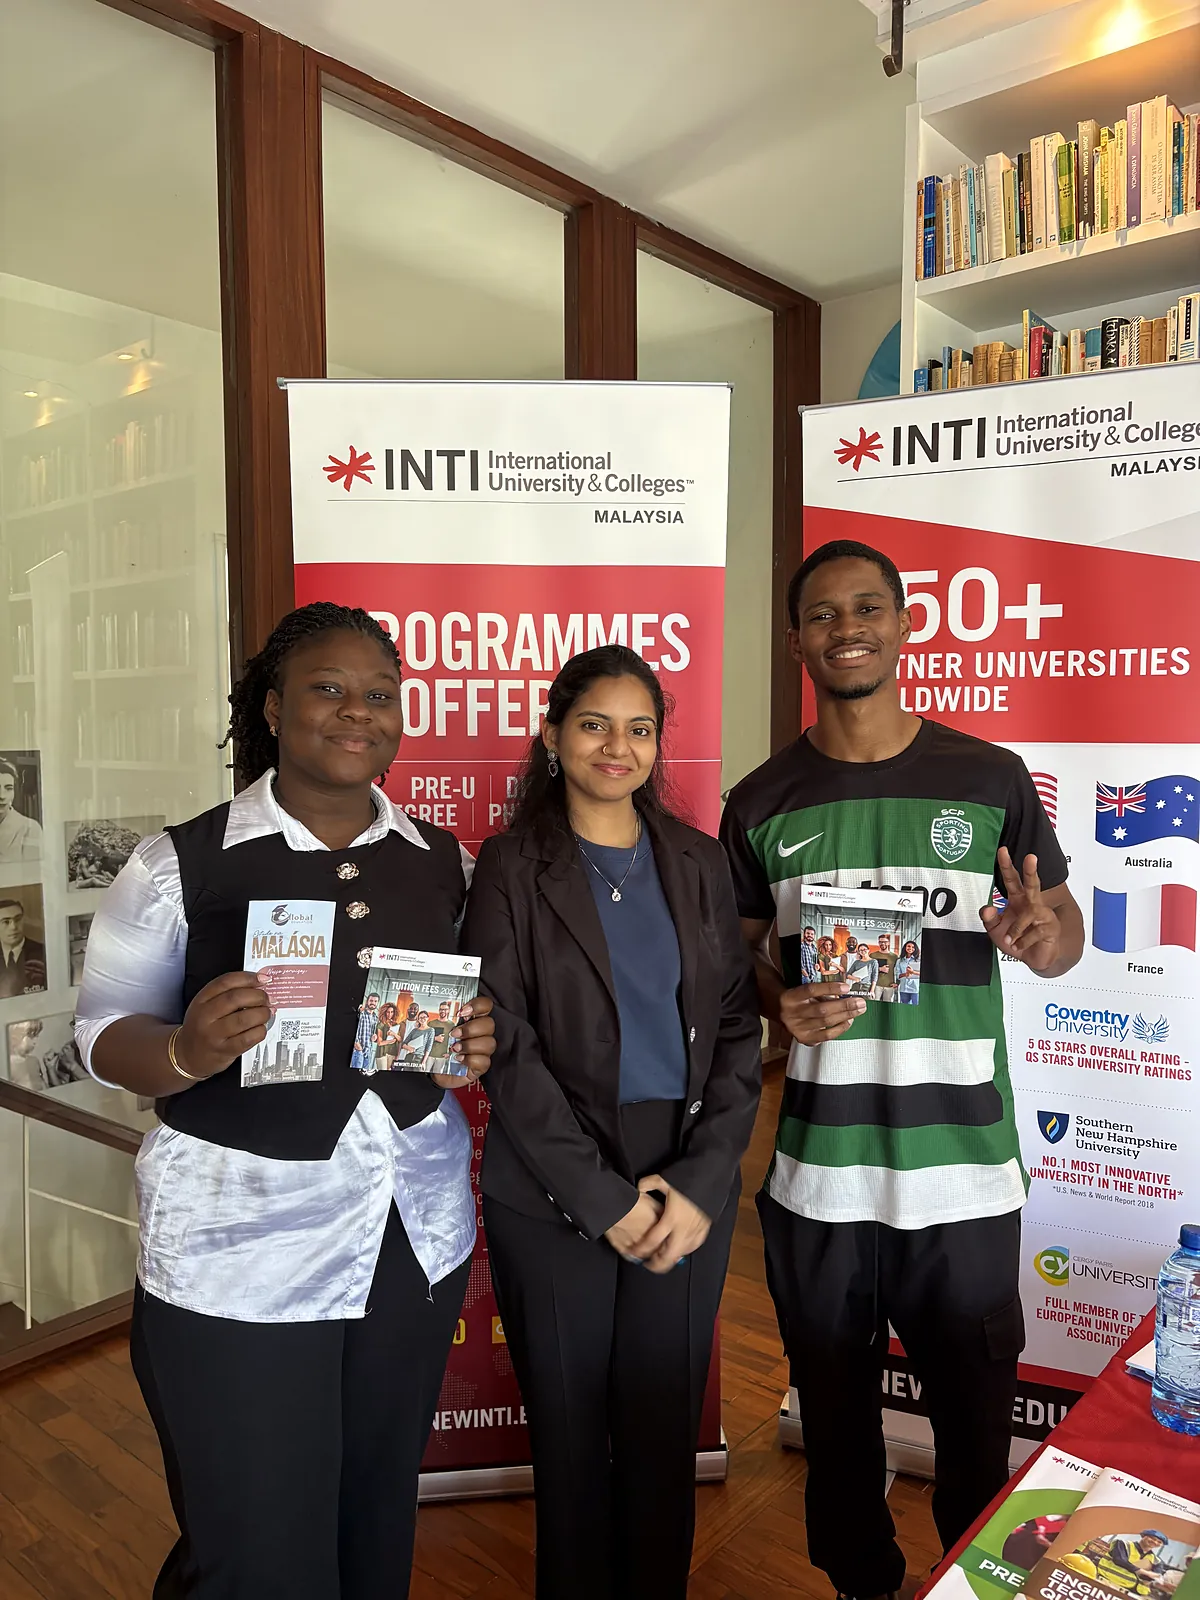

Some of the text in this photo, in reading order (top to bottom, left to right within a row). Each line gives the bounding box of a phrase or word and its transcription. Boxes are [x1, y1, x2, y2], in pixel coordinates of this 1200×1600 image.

[996, 401, 1133, 434] International
[892, 417, 986, 466] INTI
[996, 429, 1101, 456] University
[1104, 426, 1121, 447] &
[385, 448, 479, 491] INTI
[488, 473, 585, 496] University
[588, 474, 603, 493] &
[488, 450, 612, 471] International
[594, 510, 685, 524] MALAYSIA
[975, 647, 1190, 679] UNIVERSITIES
[400, 677, 551, 738] OFFER
[900, 685, 1009, 713] LDWIDE
[411, 776, 475, 800] PRE-U
[940, 808, 965, 817] SCP
[1124, 856, 1173, 869] Australia
[824, 916, 896, 930] TUITION FEES 2026
[251, 931, 326, 959] MALÁSIA
[386, 953, 400, 962] INTI
[1127, 962, 1164, 975] France
[391, 981, 458, 996] TUITION FEES 2026
[1045, 1003, 1130, 1030] Coventry
[1046, 1017, 1129, 1042] University
[1028, 1039, 1035, 1049] 5
[1038, 1039, 1051, 1052] QS
[1054, 1041, 1087, 1055] STARS
[1090, 1046, 1137, 1061] OVERALL
[1140, 1051, 1180, 1066] RATING
[1025, 1051, 1192, 1081] QS STARS UNIVERSITY RATINGS
[1075, 1115, 1134, 1133] Southern
[1075, 1127, 1178, 1151] New Hampshire
[1075, 1139, 1140, 1160] University
[1029, 1167, 1094, 1187] UNIVERSITY
[1098, 1178, 1110, 1189] IN
[1113, 1180, 1134, 1194] THE
[1042, 1156, 1171, 1186] NO.1 MOST INNOVATIVE
[1070, 1188, 1087, 1197] News
[1089, 1191, 1094, 1199] &
[1095, 1192, 1113, 1202] World
[1115, 1196, 1136, 1207] Report
[1137, 1199, 1154, 1209] 2018
[1072, 1262, 1158, 1291] UNIVERSIT
[1036, 1308, 1137, 1336] EUROPEAN UNIVER
[1045, 1296, 1070, 1311] FULL
[1073, 1301, 1119, 1320] MEMBER
[1122, 1312, 1136, 1323] OF
[1065, 1461, 1091, 1477] INTI
[1124, 1480, 1152, 1498] INTI
